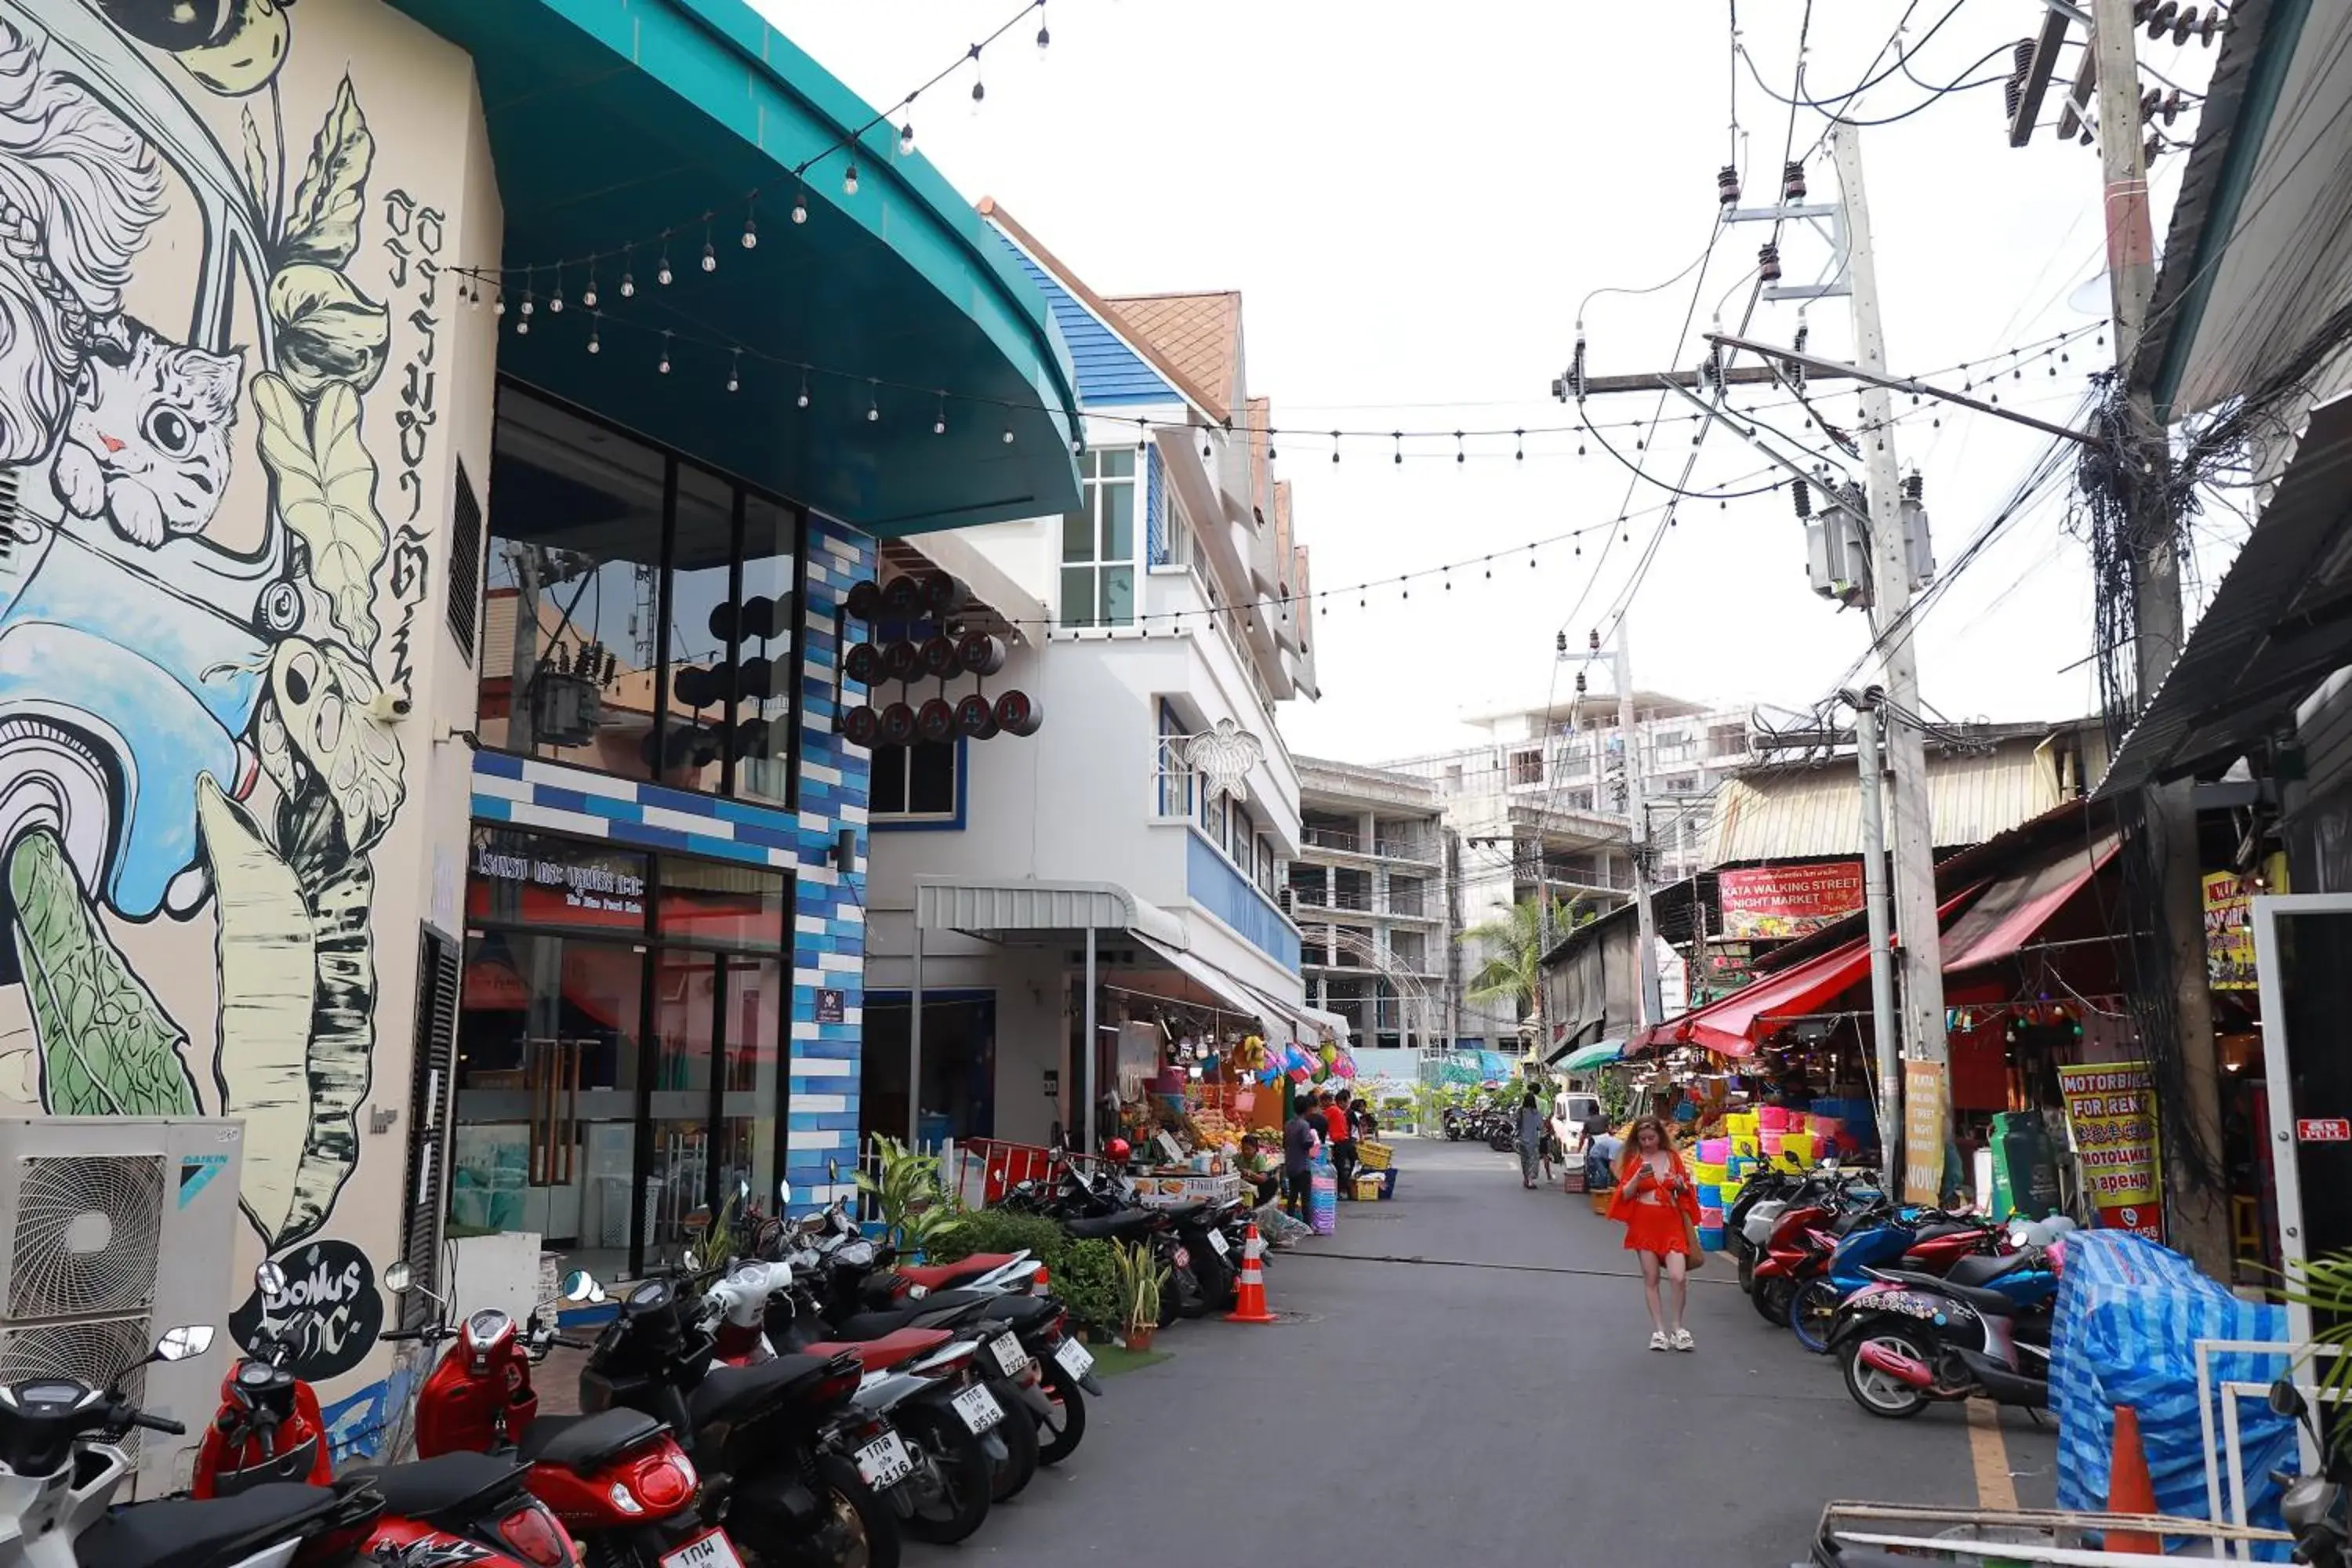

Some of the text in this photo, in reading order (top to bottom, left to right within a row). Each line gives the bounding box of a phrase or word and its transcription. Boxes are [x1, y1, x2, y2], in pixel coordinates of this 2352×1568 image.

[1723, 877, 1858, 897] KATA WALKING STREET
[1733, 893, 1820, 909] NIGHT MARKET
[2072, 1095, 2147, 1117] FOR RENT
[1907, 1164, 1936, 1191] NOW
[973, 1408, 1000, 1431] 9515
[874, 1461, 909, 1488] 2416
